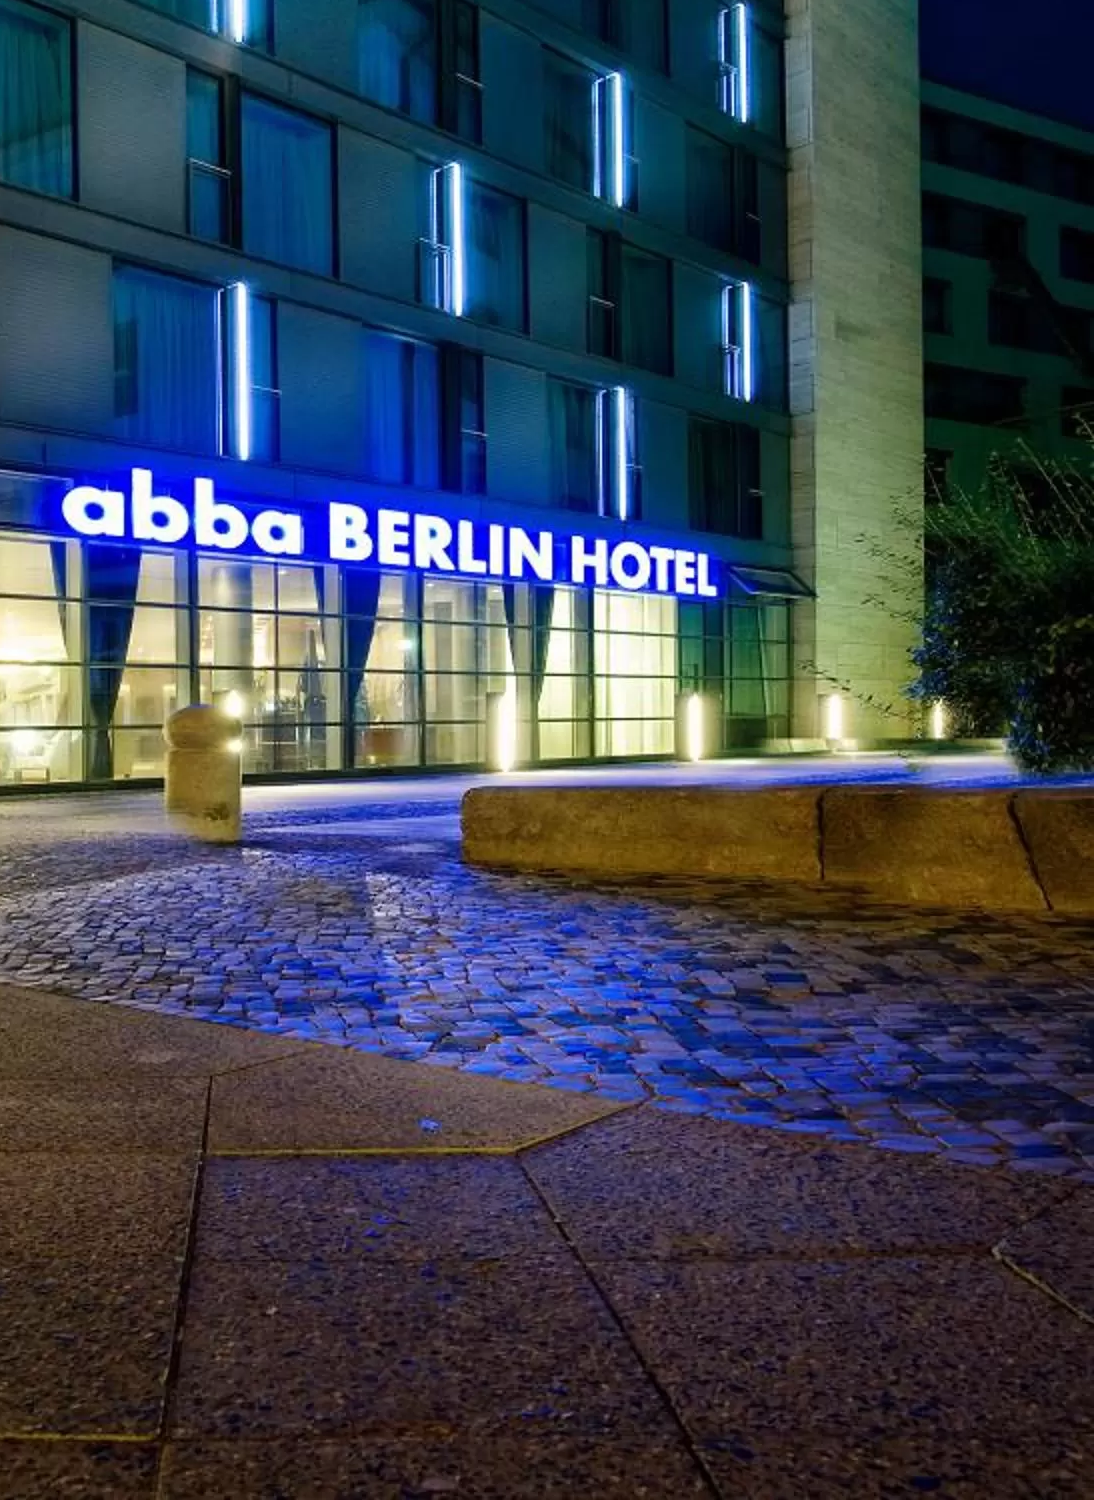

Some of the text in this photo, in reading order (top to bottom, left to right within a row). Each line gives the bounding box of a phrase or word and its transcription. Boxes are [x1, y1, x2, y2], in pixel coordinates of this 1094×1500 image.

[61, 467, 718, 598] abba BERLIN HOTEL
